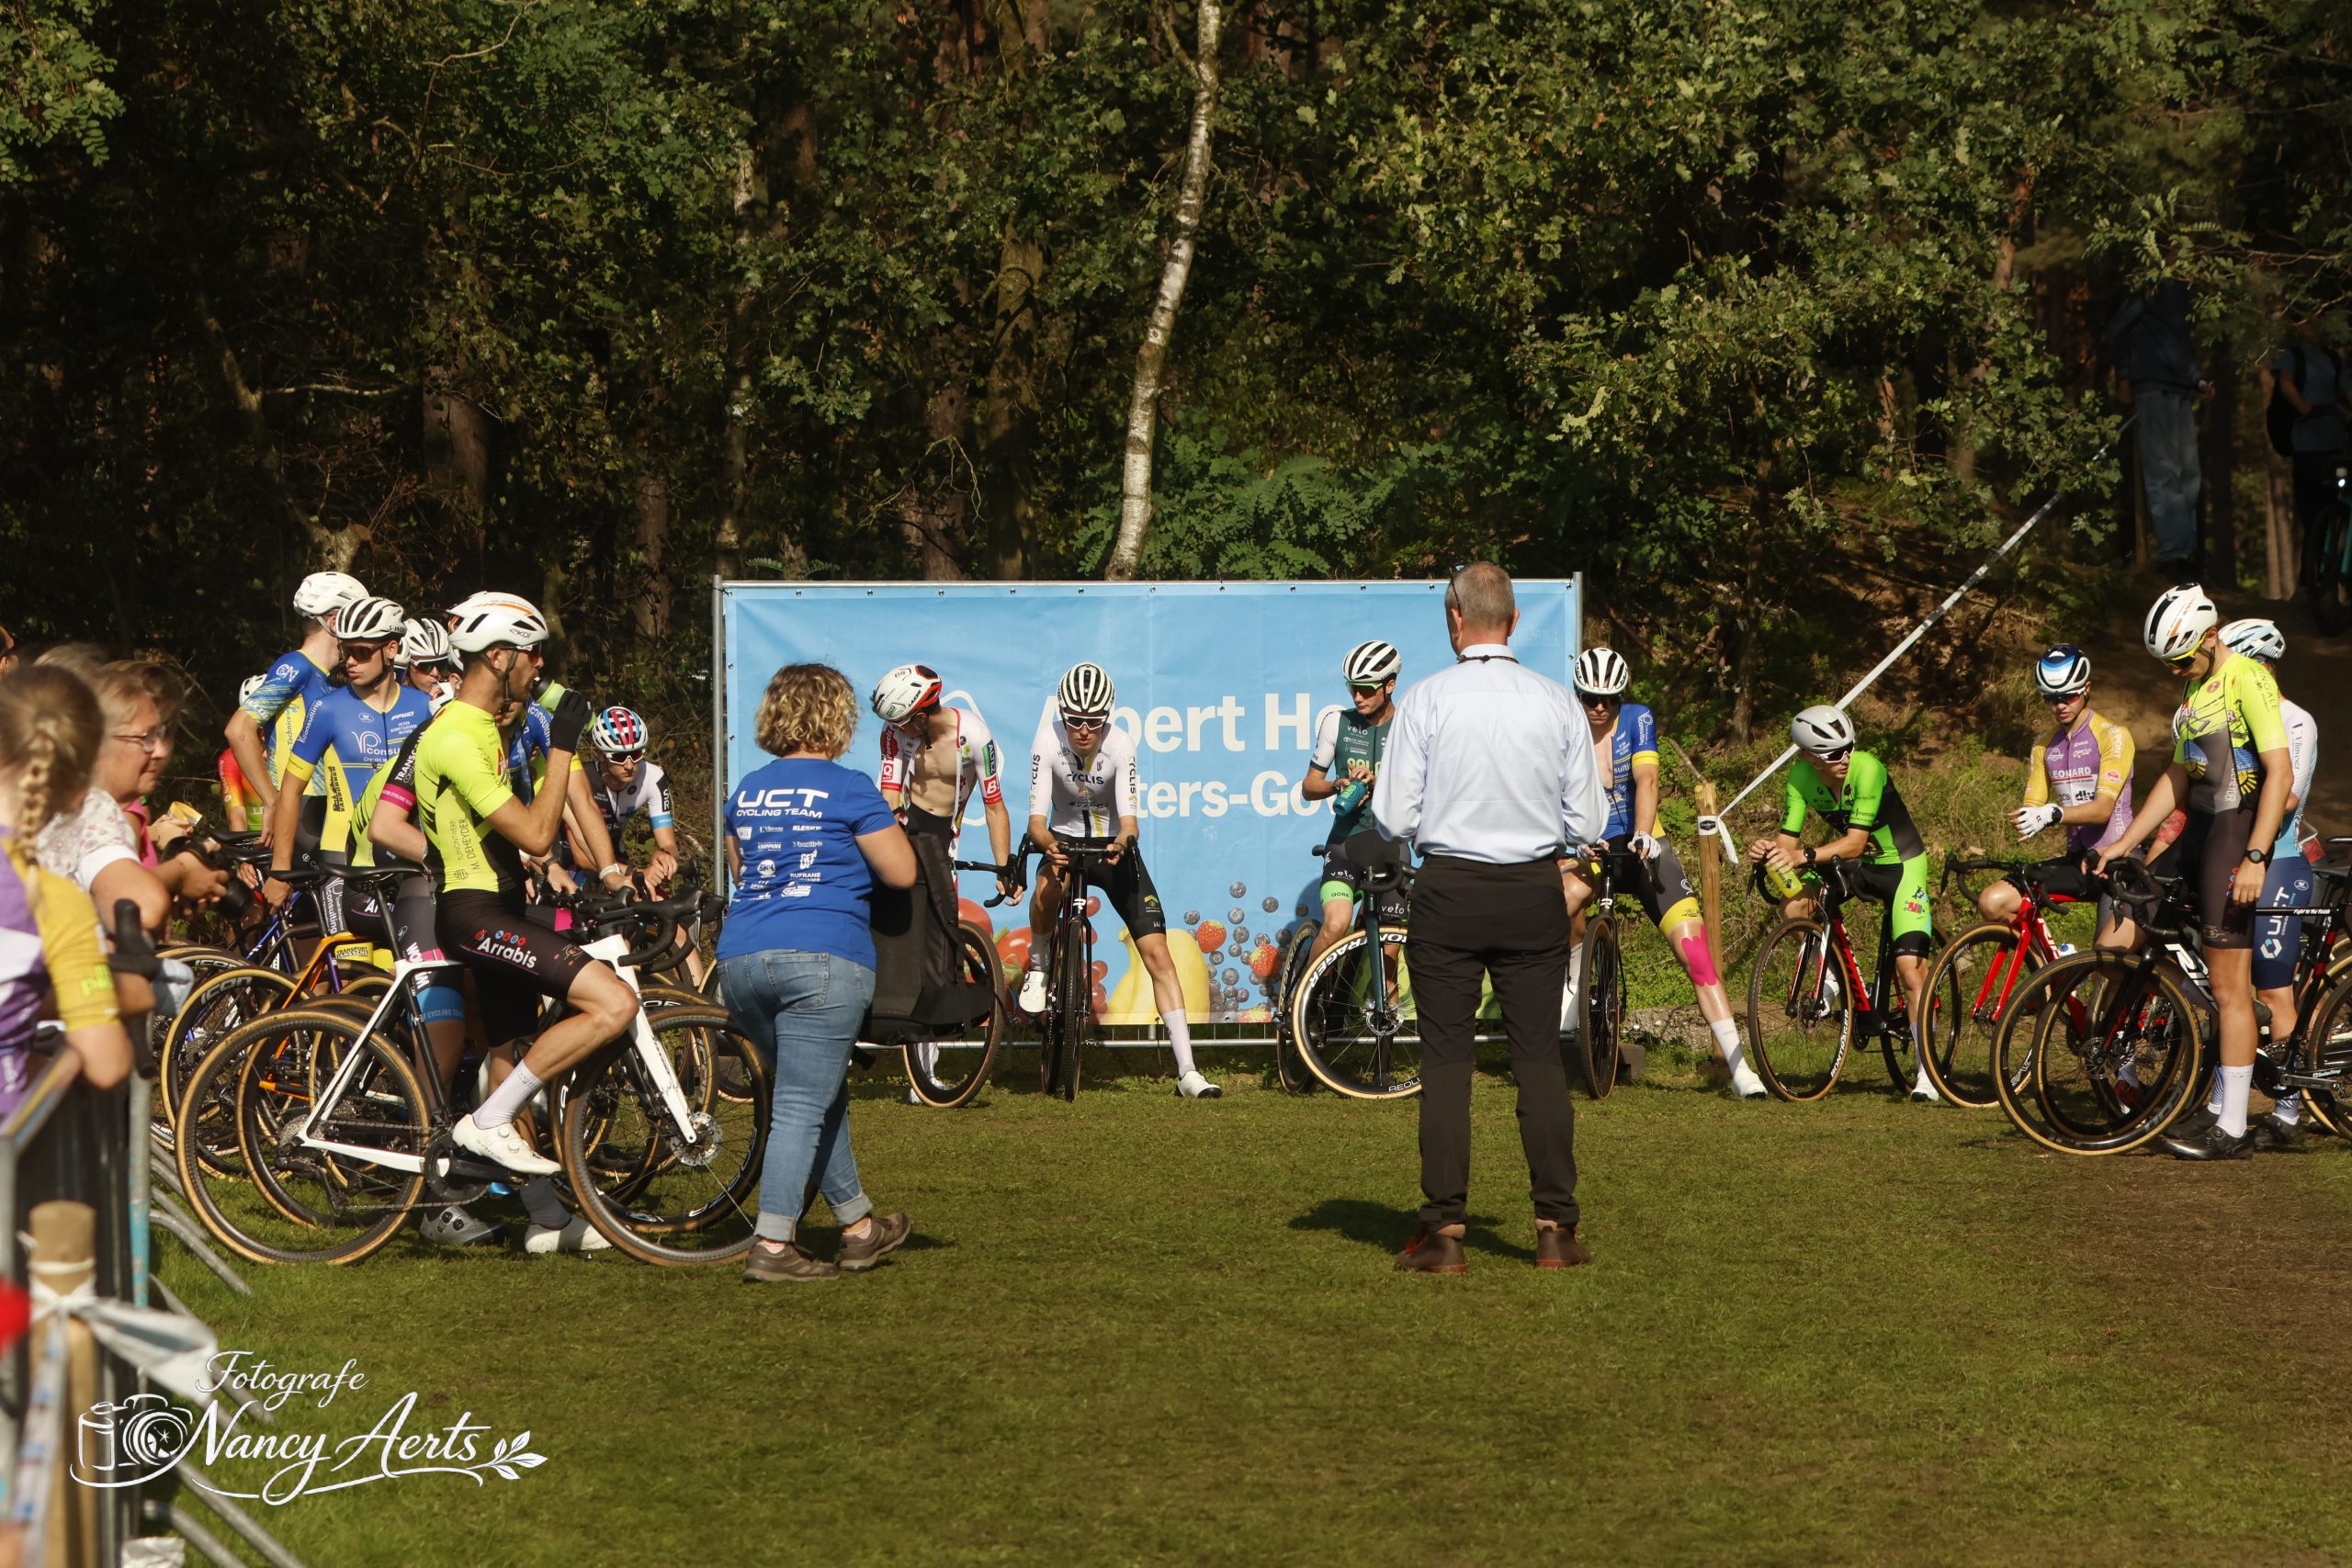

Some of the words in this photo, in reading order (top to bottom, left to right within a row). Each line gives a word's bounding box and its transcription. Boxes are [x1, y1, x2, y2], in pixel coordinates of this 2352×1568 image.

[1347, 725, 1368, 735] velo
[738, 788, 830, 807] UCT
[737, 808, 781, 817] CYCLING
[785, 808, 823, 818] TEAM
[1330, 870, 1354, 880] velo
[325, 889, 339, 934] consulting
[1381, 903, 1405, 915] velo
[478, 937, 537, 968] Arrabis
[1831, 1009, 1849, 1078] BONTRAGER
